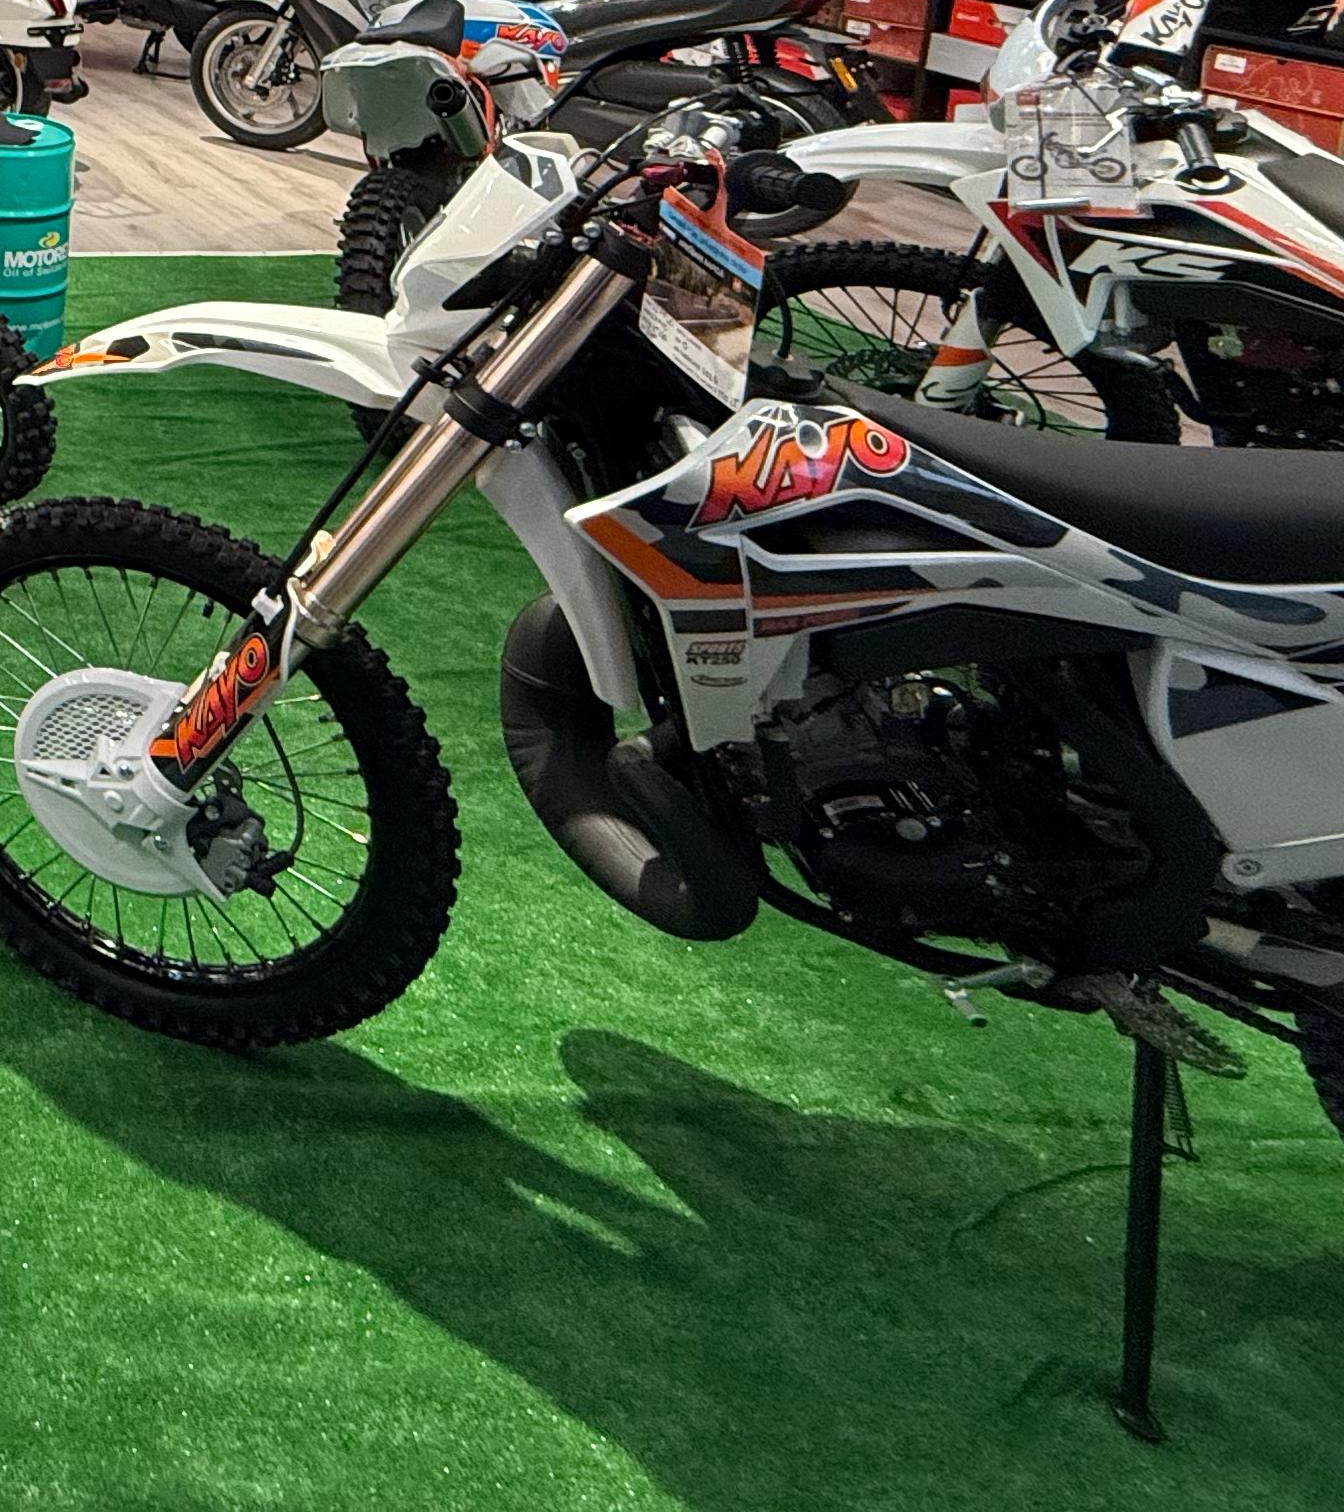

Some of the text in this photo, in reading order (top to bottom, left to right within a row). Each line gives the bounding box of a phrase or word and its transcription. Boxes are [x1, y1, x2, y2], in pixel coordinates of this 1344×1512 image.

[497, 22, 569, 54] KAYO
[687, 416, 912, 532] KAYO
[175, 632, 270, 774] KAYO
